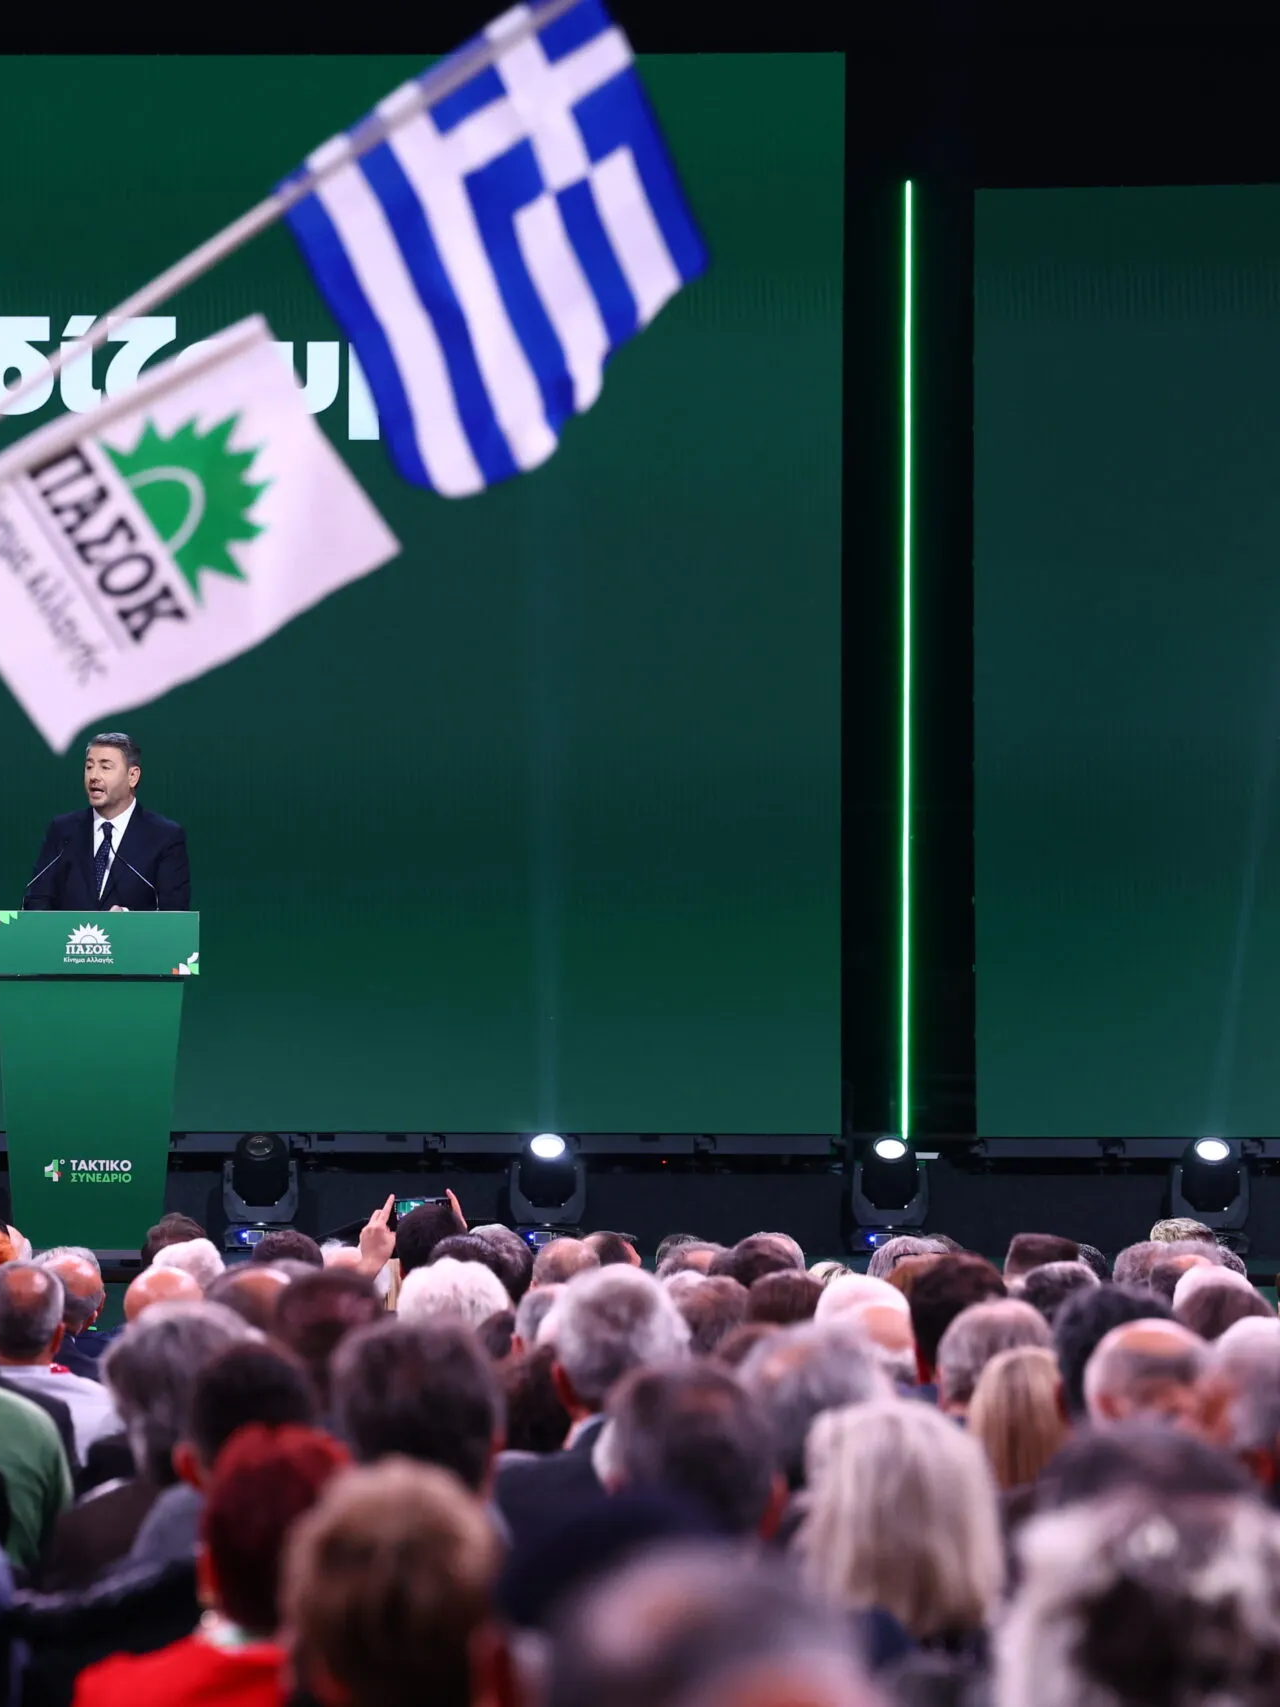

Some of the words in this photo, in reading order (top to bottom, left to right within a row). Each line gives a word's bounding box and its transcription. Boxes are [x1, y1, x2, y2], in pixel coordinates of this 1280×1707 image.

[26, 444, 188, 643] ΠΑΣΟΚ
[65, 944, 112, 955] ΠΑΣΟΚ
[86, 956, 114, 964] Αλλαγής
[70, 1159, 132, 1172] ΤΑΚΤΙΚΟ
[70, 1172, 132, 1184] ΣΥΝΕΔΡΙΟ
